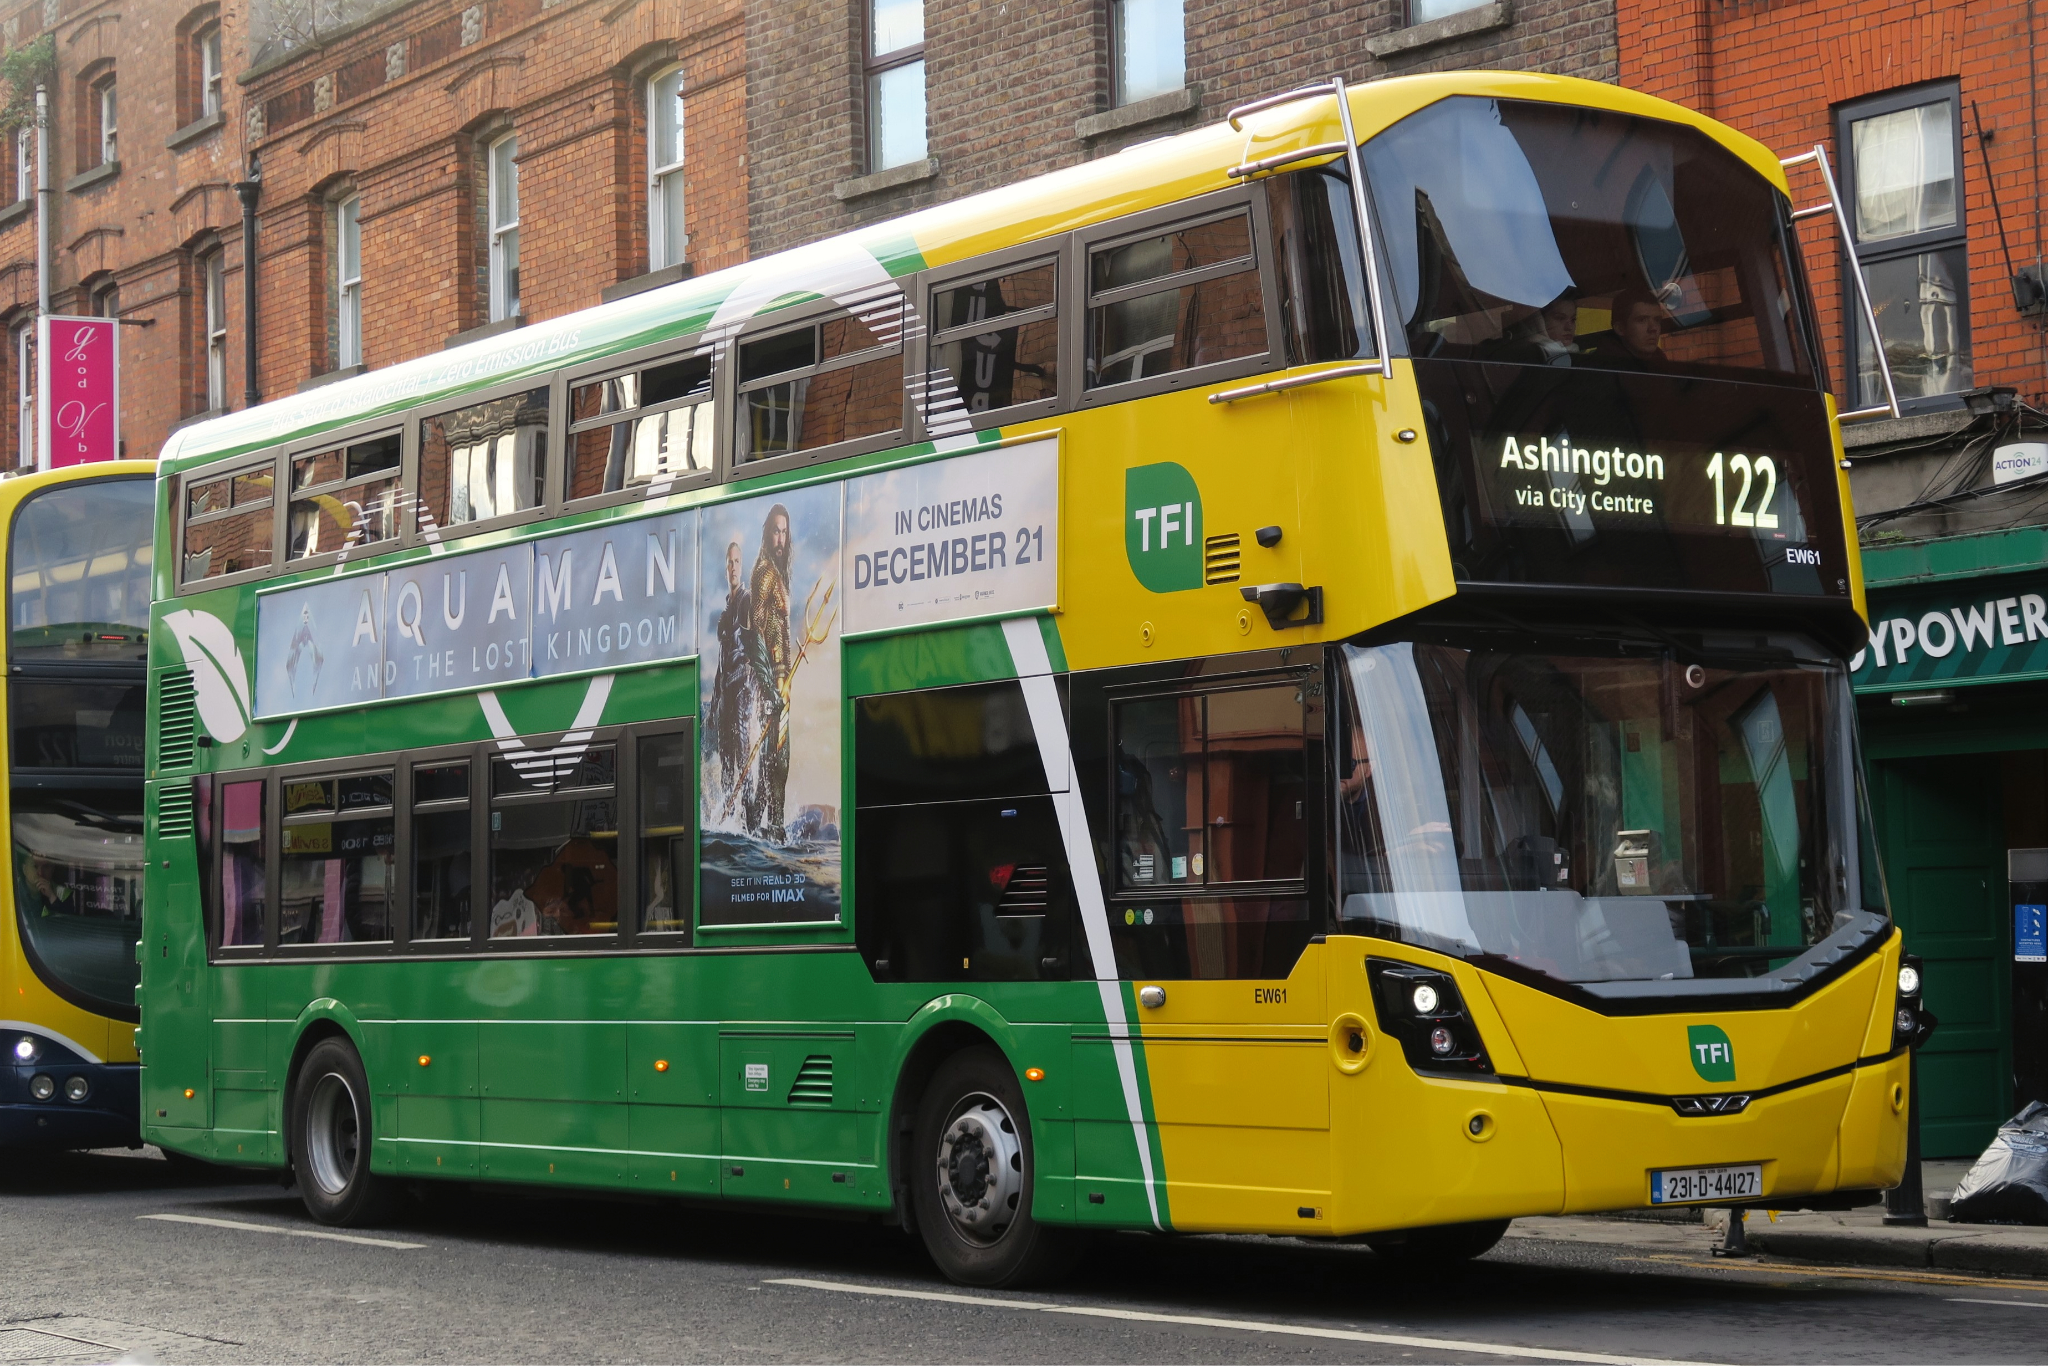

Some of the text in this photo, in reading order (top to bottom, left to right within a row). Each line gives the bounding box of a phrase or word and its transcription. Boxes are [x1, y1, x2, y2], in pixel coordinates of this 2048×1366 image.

[436, 361, 472, 385] Zero
[475, 338, 546, 375] Emission
[548, 329, 581, 355] Bus
[1501, 436, 1778, 528] Ashington 122
[895, 493, 1003, 535] IN CINEMAS
[1515, 486, 1653, 515] via City Centre
[1135, 502, 1193, 552] TFI
[854, 525, 1043, 590] DECEMBER 21
[1786, 548, 1821, 565] EW61
[352, 529, 677, 647] AQUAMAN
[351, 615, 676, 691] AND THE LOST KINGDOM
[731, 878, 745, 887] SEE
[746, 877, 753, 886] IT
[754, 877, 762, 885] IN
[731, 888, 805, 903] FILMED FOR IMAX
[1255, 988, 1287, 1004] EW61
[1695, 1042, 1730, 1065] TFI
[1669, 1172, 1755, 1199] 231-D-44127
